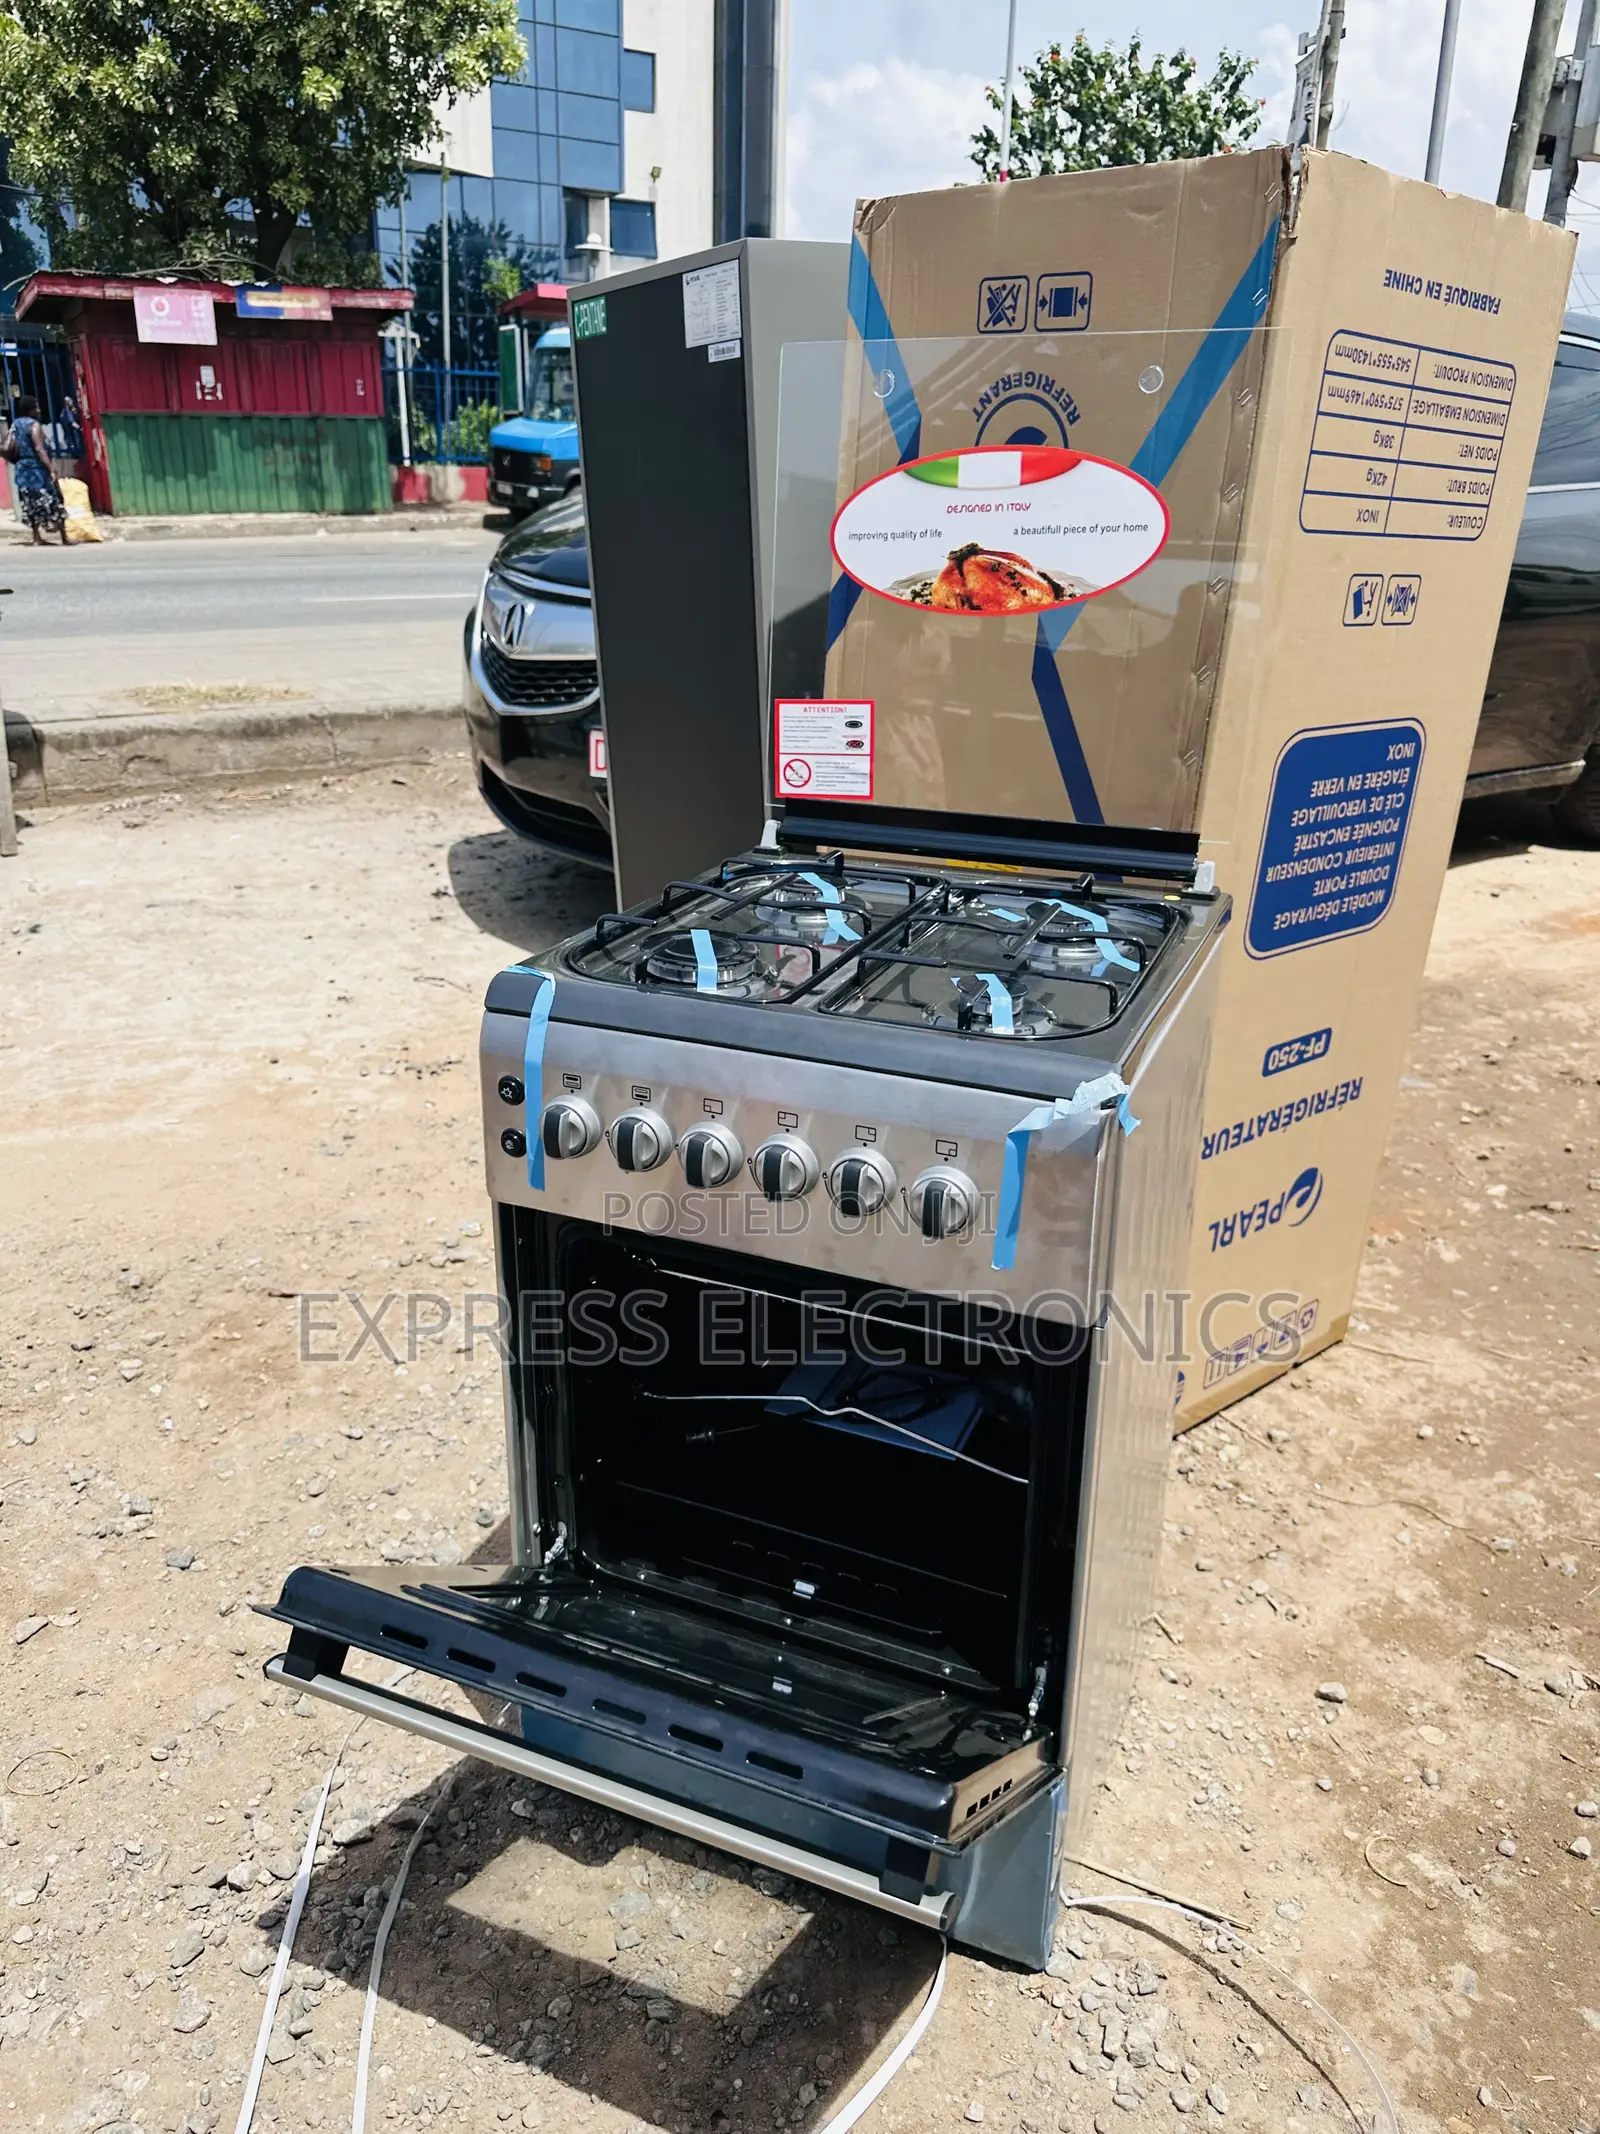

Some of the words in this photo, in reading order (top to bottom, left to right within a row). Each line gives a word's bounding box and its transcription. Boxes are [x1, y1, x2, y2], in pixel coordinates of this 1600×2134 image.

[1383, 268, 1422, 296] CHINE
[1425, 285, 1442, 300] EN
[1444, 288, 1502, 315] FABRIQUÉ
[1432, 364, 1470, 383] PRODUIT:
[1470, 372, 1514, 391] DIMENSION
[972, 371, 1081, 426] REFRIGERANT
[1411, 399, 1462, 419] EMBALLAGE:
[1462, 406, 1506, 426] DIMENSION
[1373, 430, 1396, 449] 38Kg
[1458, 444, 1474, 458] NET:
[1476, 446, 1498, 462] POIDS
[1366, 468, 1388, 487] 42Kg
[1446, 479, 1468, 493] BRUT:
[1468, 480, 1490, 496] POIDS
[946, 503, 992, 514] DESIGNED
[1006, 502, 1032, 512] ITALY
[1356, 508, 1380, 524] INOX
[1013, 528, 1019, 536] a
[1020, 525, 1062, 536] beautifull
[1062, 525, 1088, 538] piece
[1089, 524, 1098, 534] of
[1100, 524, 1121, 536] your
[1122, 522, 1149, 532] home
[1447, 514, 1484, 530] COULEUR:
[848, 530, 888, 542] improving
[890, 529, 918, 542] quality
[919, 528, 928, 539] of
[929, 528, 942, 539] life
[803, 706, 848, 714] ATTENTION!
[1386, 742, 1416, 760] INOX
[1310, 777, 1345, 797] VERRE
[1348, 774, 1363, 790] EN
[1363, 767, 1410, 791] ÉTAGÈRE
[1291, 798, 1367, 827] VEROUILLAGE
[1369, 796, 1384, 811] DE
[1384, 792, 1405, 814] CLÉ
[1353, 816, 1400, 844] POIGNÉE
[1293, 826, 1351, 856] ENCASTRÉ
[1346, 840, 1396, 865] INTÉRIEUR
[1266, 852, 1343, 883] CONDENSEUR
[1348, 864, 1390, 886] DOUBLE
[1312, 876, 1348, 896] PORTE
[1341, 888, 1385, 914] MODÈLE
[1273, 901, 1341, 931] DÉGIVRAGE
[1267, 1032, 1327, 1072] PF-250
[1200, 1076, 1364, 1161] RÉFRIGÉRATEUR
[1208, 1191, 1286, 1252] PEARL
